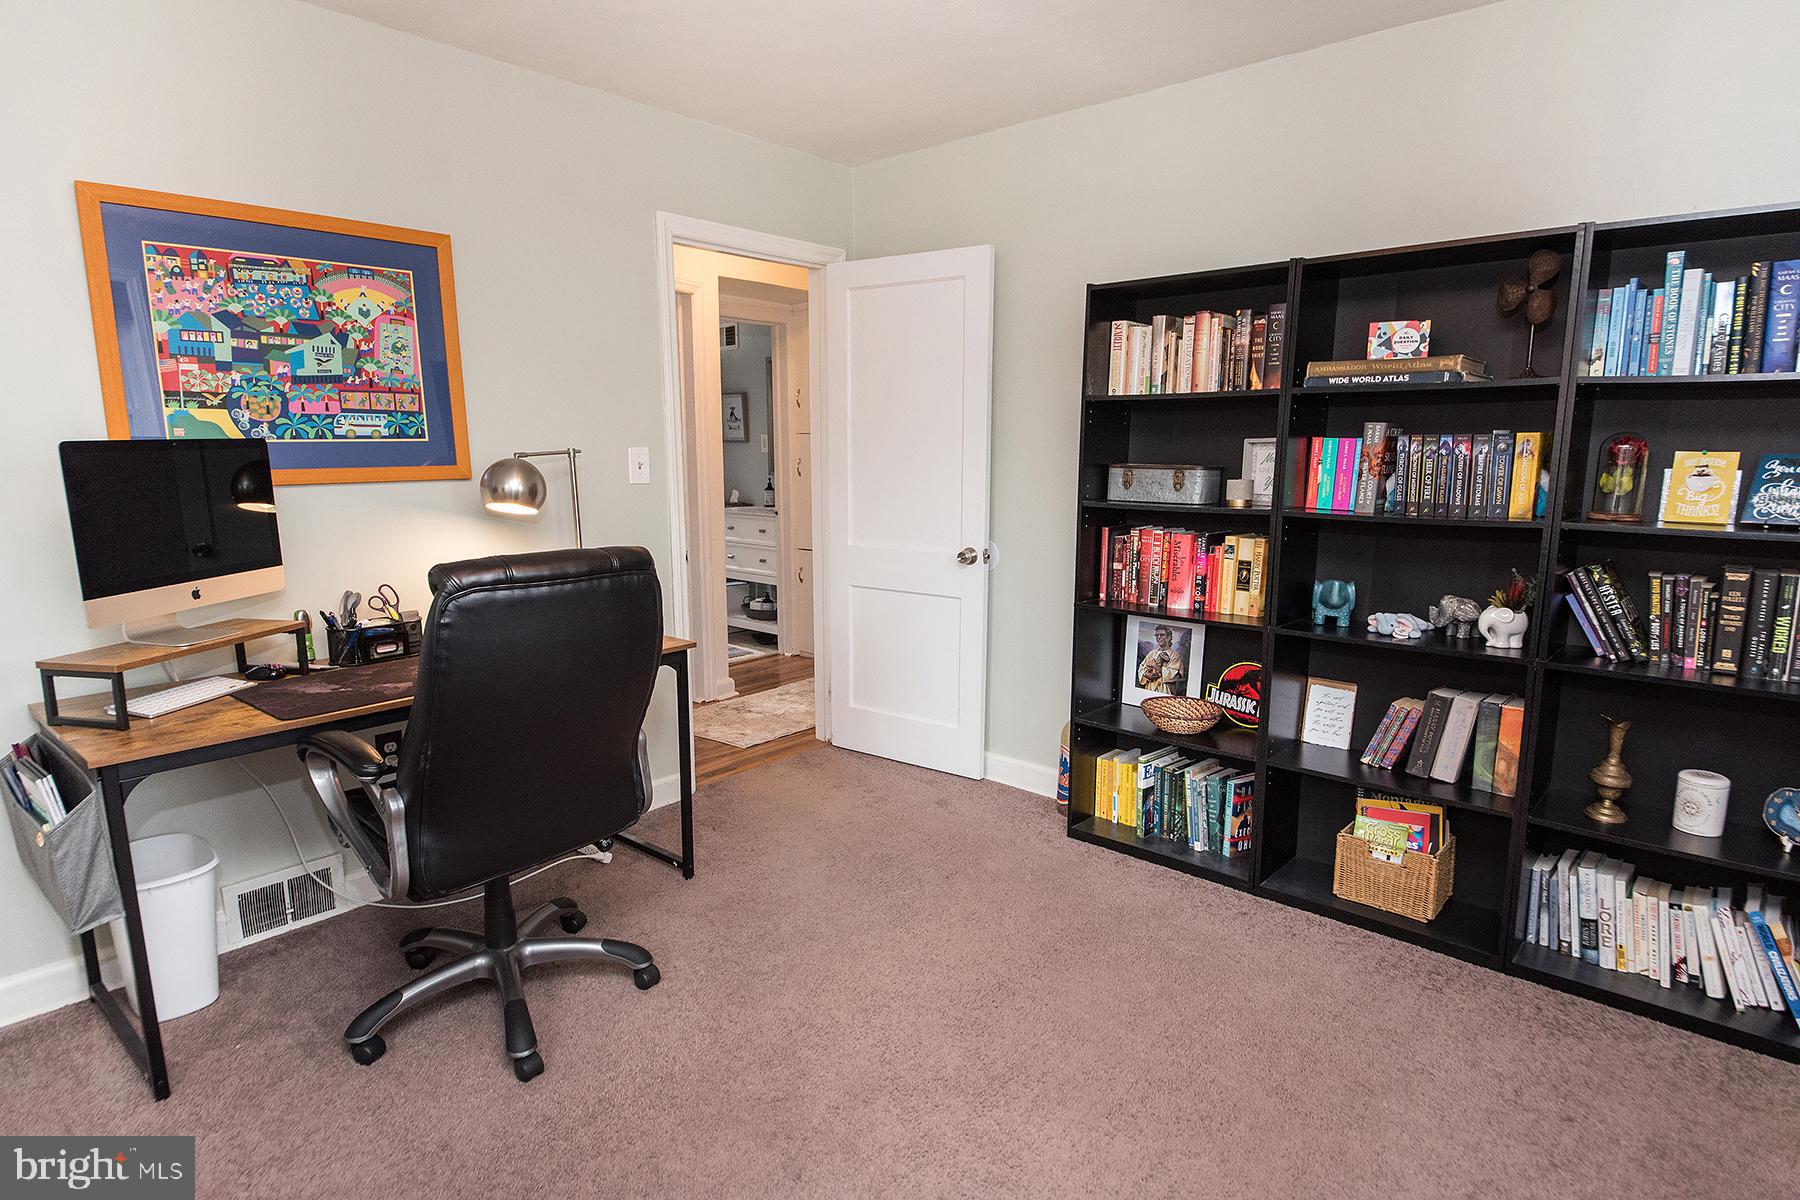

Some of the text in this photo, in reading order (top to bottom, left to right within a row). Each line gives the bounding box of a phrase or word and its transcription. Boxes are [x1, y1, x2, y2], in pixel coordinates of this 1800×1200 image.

[1670, 269, 1680, 286] THE
[1738, 283, 1746, 294] THE
[1758, 279, 1766, 314] DICTIONARY
[1668, 288, 1679, 310] BOOK
[1736, 296, 1744, 311] ONLY
[1668, 312, 1677, 323] OF
[1714, 313, 1730, 333] City
[1734, 313, 1744, 330] CHILD
[1112, 322, 1123, 351] SCARLETT
[1664, 324, 1676, 355] STONES
[1713, 344, 1725, 372] Ashes
[1753, 340, 1761, 361] WORDS
[1314, 364, 1367, 372] AMBASSADOR
[1520, 453, 1529, 482] KINGDOM
[1425, 475, 1431, 485] OF
[1497, 477, 1504, 486] OF
[1676, 503, 1720, 516] THANKS!
[1171, 540, 1182, 581] Misérables
[1196, 575, 1202, 584] BE
[1652, 579, 1660, 593] DAVID
[1578, 573, 1592, 594] BRITNEY
[1590, 595, 1603, 615] SPEARS
[1598, 584, 1623, 616] HESTER
[1652, 594, 1660, 615] IGNATIUS
[1758, 600, 1767, 621] WATERS
[1651, 622, 1660, 635] BODY
[1771, 616, 1791, 654] WICKED
[1651, 640, 1660, 650] LIES
[1750, 637, 1758, 657] GUESTS
[1756, 644, 1764, 664] PAYING
[1208, 688, 1256, 714] JURASSIC
[1366, 823, 1400, 839] Cross
[1600, 898, 1612, 948] LORE
[1756, 925, 1798, 1001] WORLD CIVILIZATIONS
